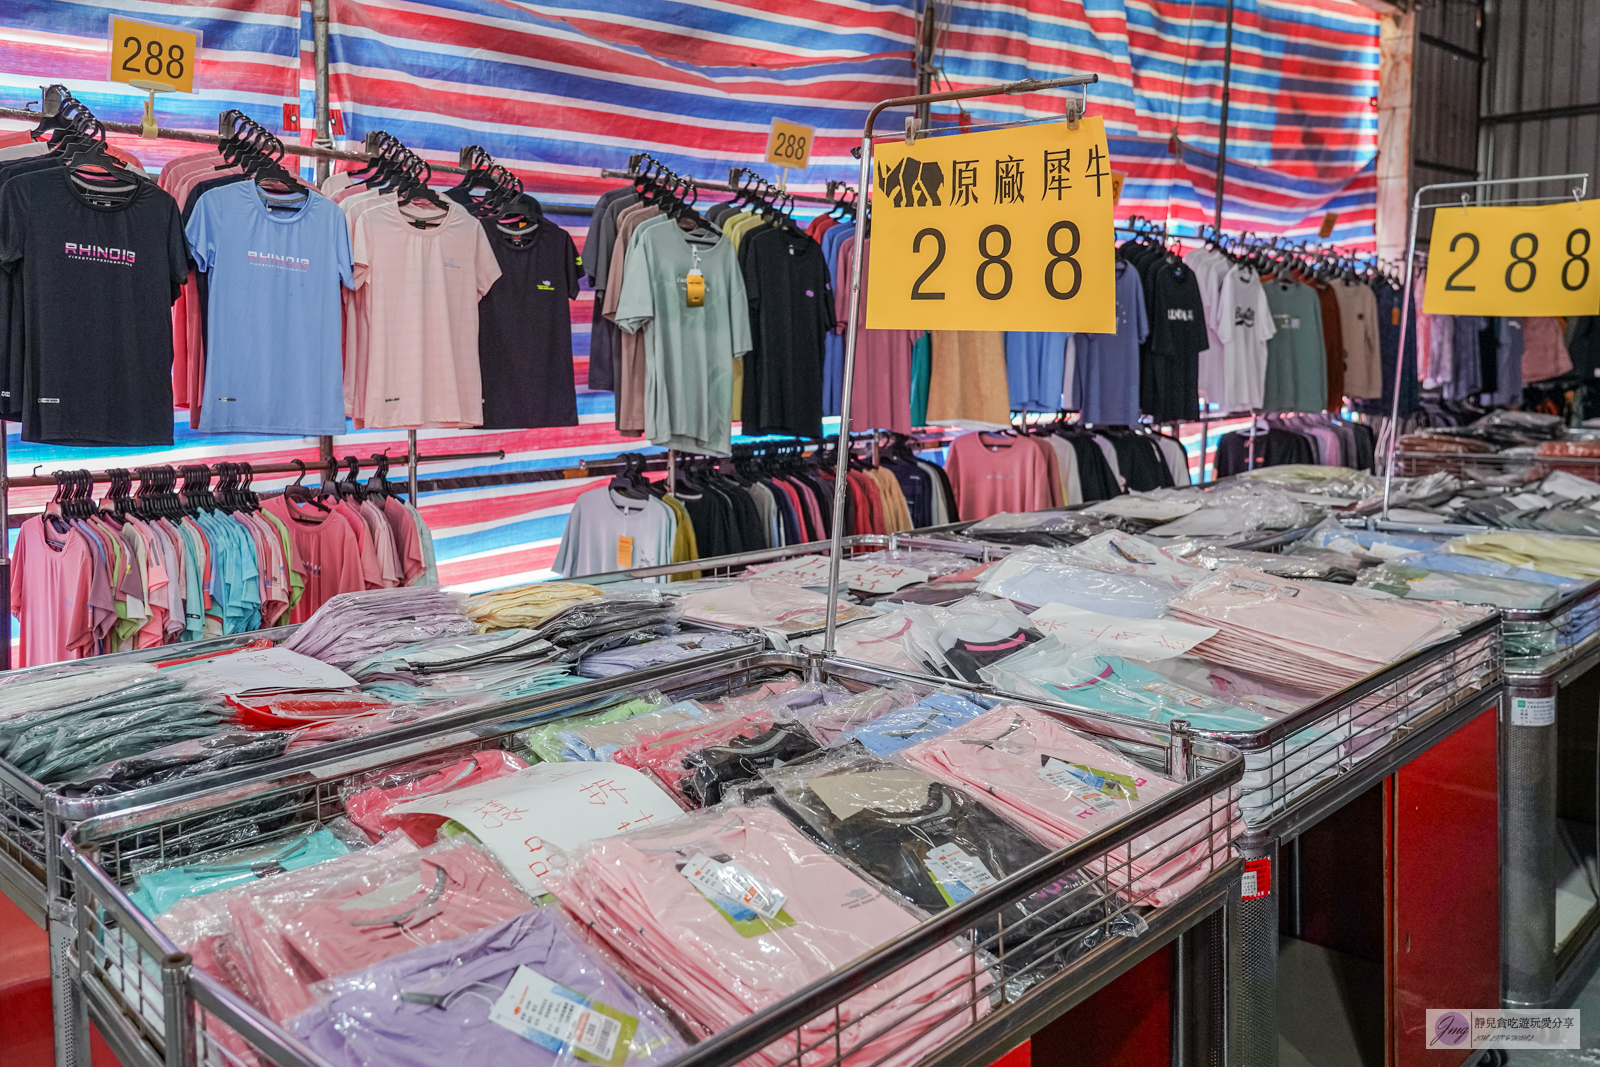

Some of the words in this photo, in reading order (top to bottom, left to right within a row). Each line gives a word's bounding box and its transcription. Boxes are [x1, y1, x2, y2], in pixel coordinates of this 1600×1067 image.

[122, 36, 184, 79] 288
[774, 132, 806, 160] 288
[950, 144, 1110, 207] 原廠犀牛
[911, 220, 1083, 300] 288
[1444, 228, 1591, 293] 288
